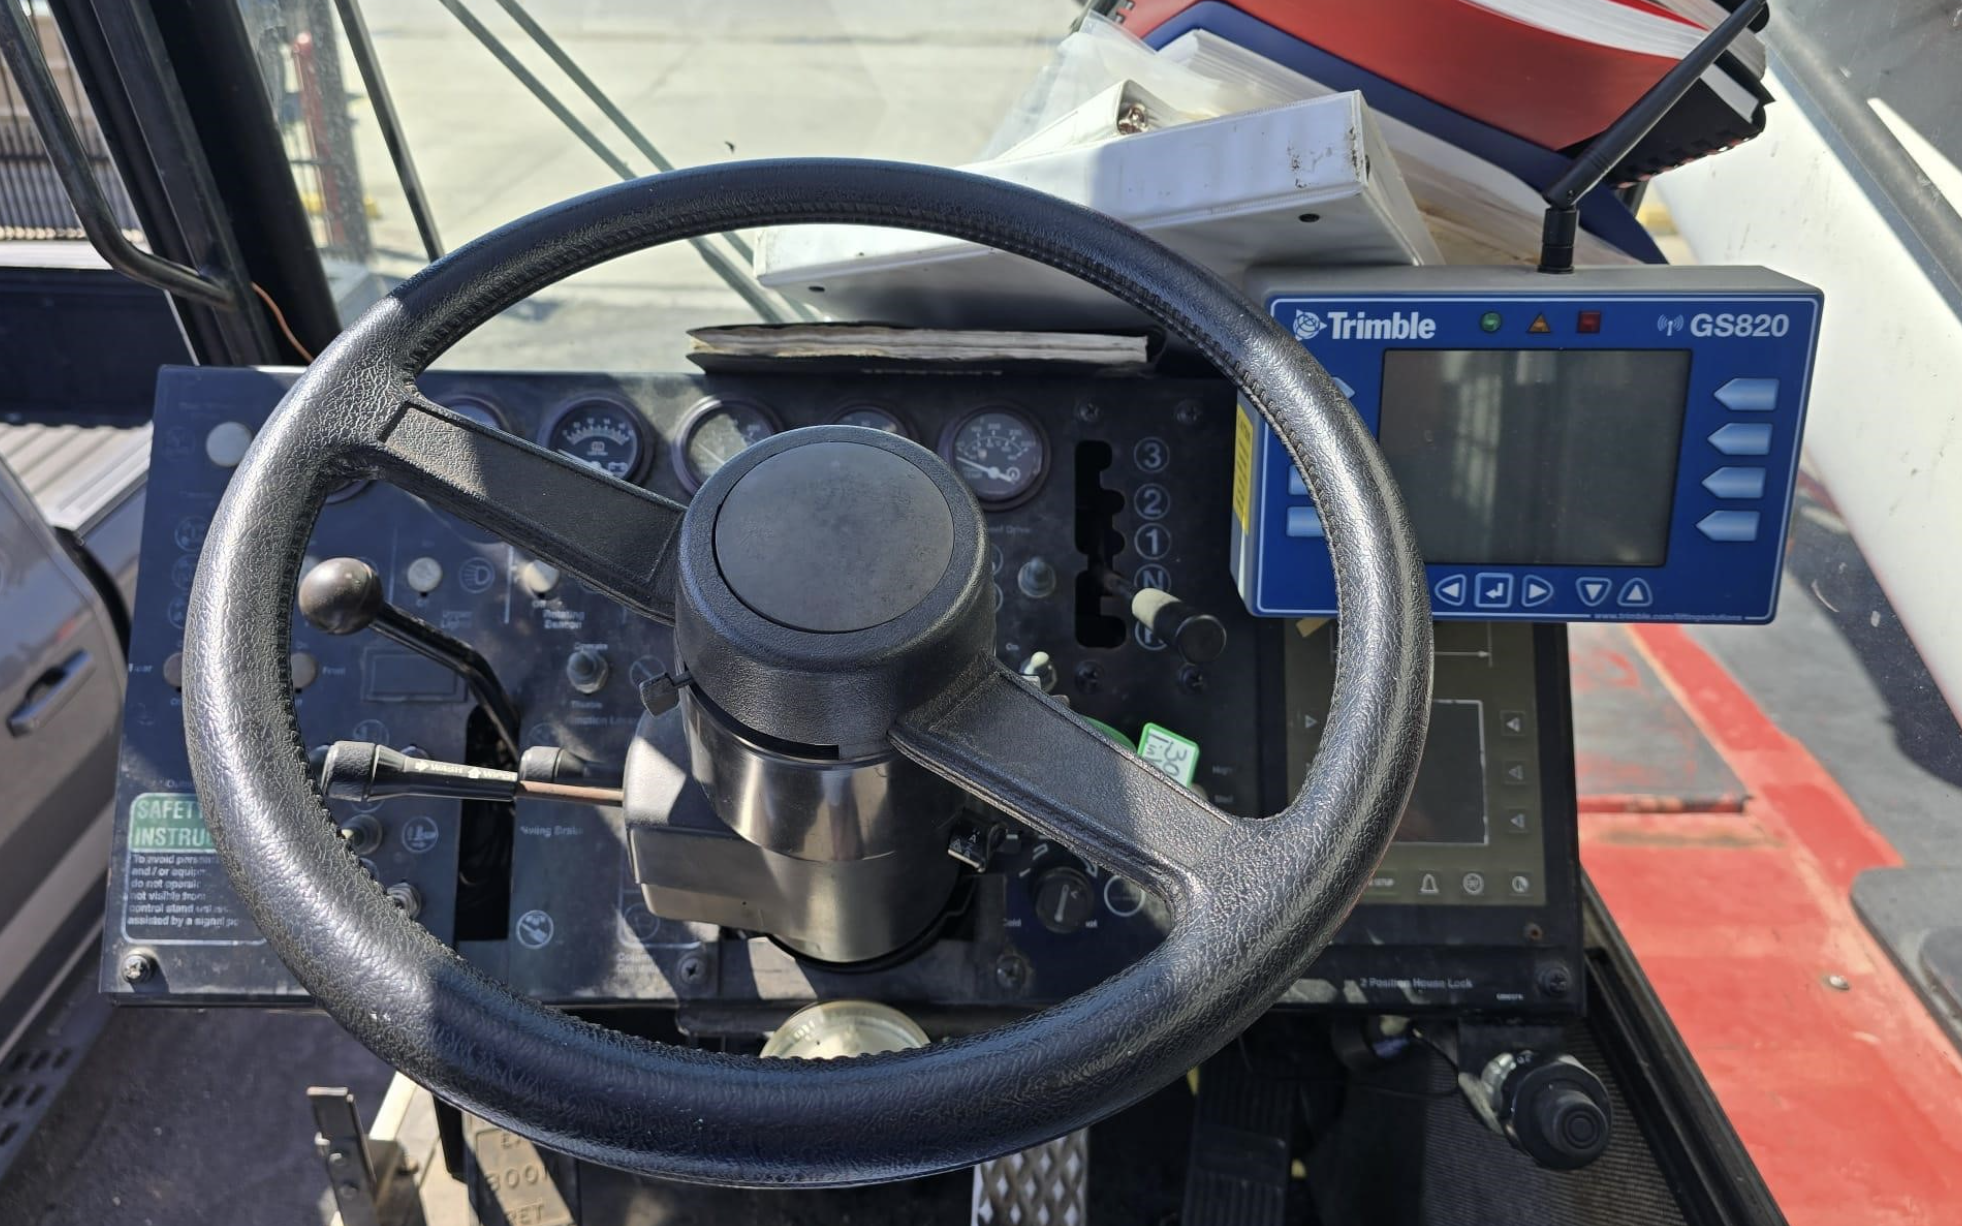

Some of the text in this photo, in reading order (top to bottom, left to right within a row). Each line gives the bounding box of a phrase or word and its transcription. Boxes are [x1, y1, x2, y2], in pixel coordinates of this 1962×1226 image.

[1327, 311, 1437, 340] Trimble
[1690, 313, 1790, 338] GS820
[1144, 442, 1162, 469] 3
[1143, 489, 1162, 515] 2
[1146, 528, 1159, 555] 1
